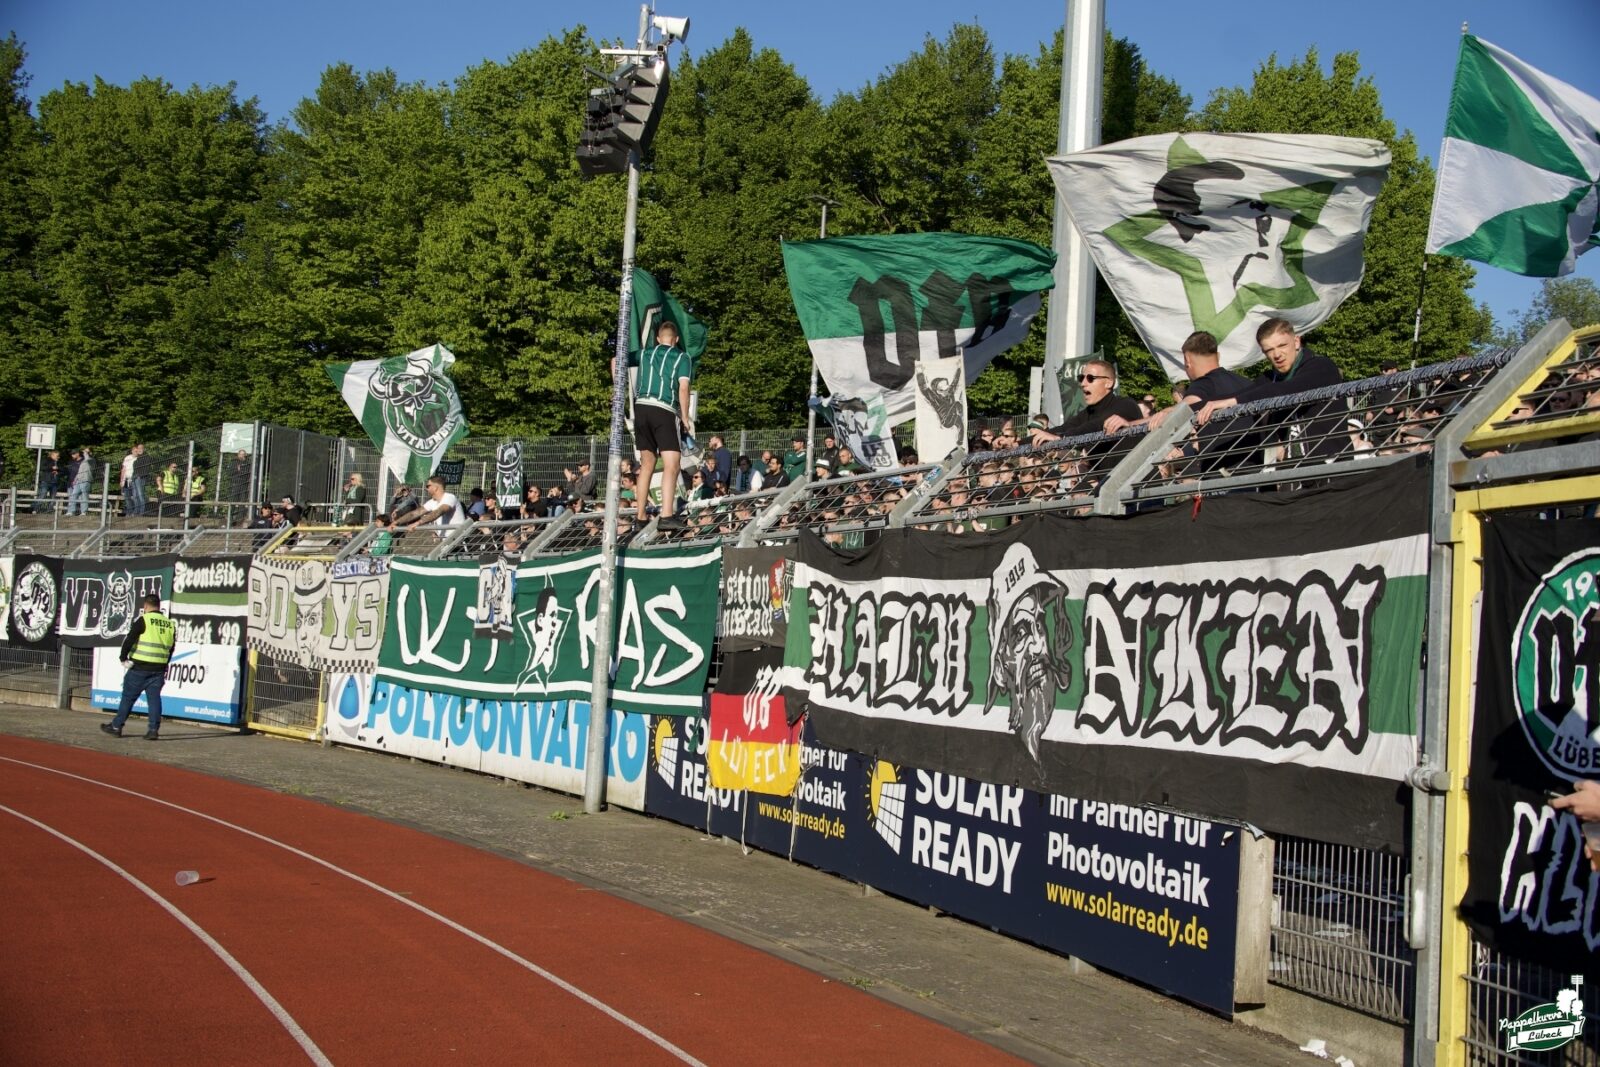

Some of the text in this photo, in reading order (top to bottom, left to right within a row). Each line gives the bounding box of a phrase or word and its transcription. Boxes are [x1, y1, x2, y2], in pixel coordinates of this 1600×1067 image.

[1004, 557, 1026, 594] 1919
[1563, 571, 1596, 600] 19
[368, 680, 646, 783] POLYGONVATO
[798, 776, 847, 811] voltaik
[915, 769, 1025, 827] SOLAR
[759, 801, 846, 839] www.soarready.de
[1082, 799, 1169, 839] Partner
[912, 814, 1022, 895] READY
[1047, 831, 1210, 908] Photovoltaik
[1046, 881, 1209, 951] www.solarready.de
